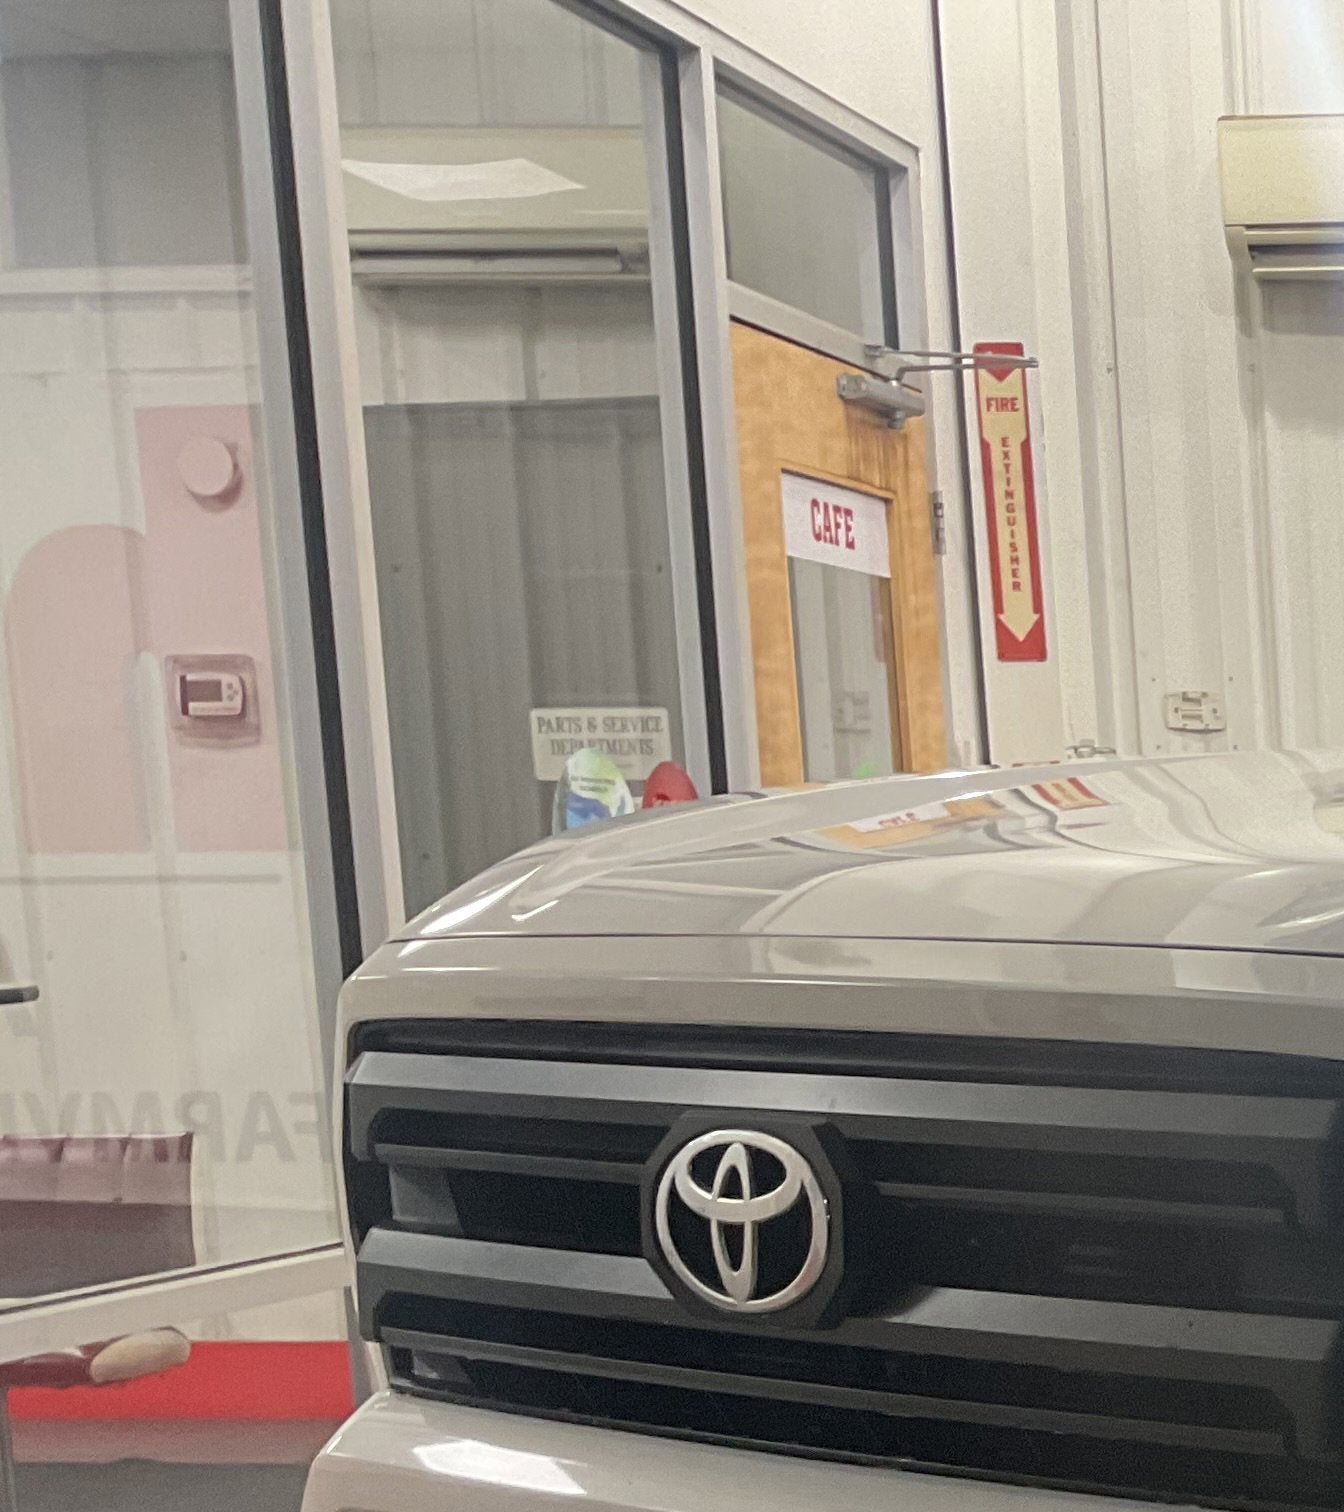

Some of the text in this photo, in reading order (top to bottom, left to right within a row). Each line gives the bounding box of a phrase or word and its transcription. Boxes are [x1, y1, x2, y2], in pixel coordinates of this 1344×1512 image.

[986, 397, 1020, 412] FIRE
[810, 498, 856, 551] CAFE
[1001, 437, 1021, 592] EXTINGUISHER
[537, 716, 664, 734] PARTS & SERVICE
